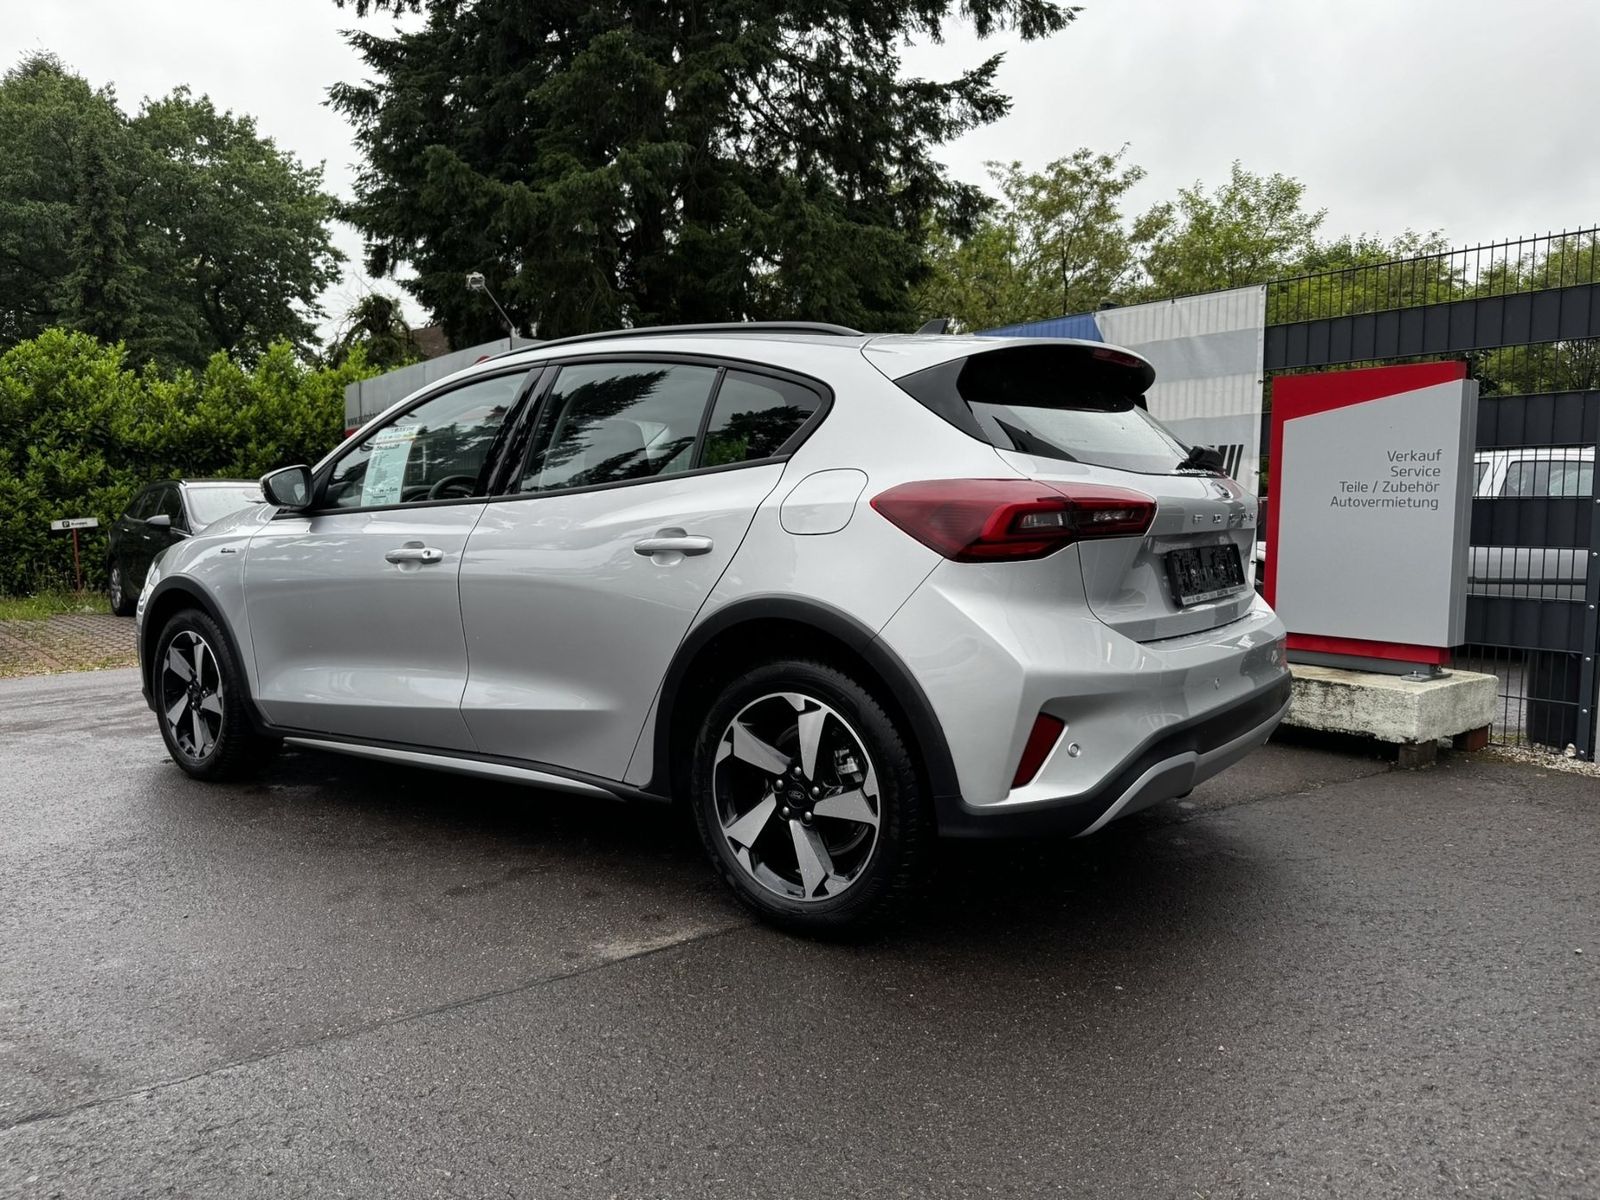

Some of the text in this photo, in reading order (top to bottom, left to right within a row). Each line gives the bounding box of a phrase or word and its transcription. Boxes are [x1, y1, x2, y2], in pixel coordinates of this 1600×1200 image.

[1387, 449, 1442, 462] Verkauf
[1390, 465, 1441, 477] Service
[1339, 480, 1440, 493] Teile / Zubehör
[1330, 496, 1439, 511] Autovermietung
